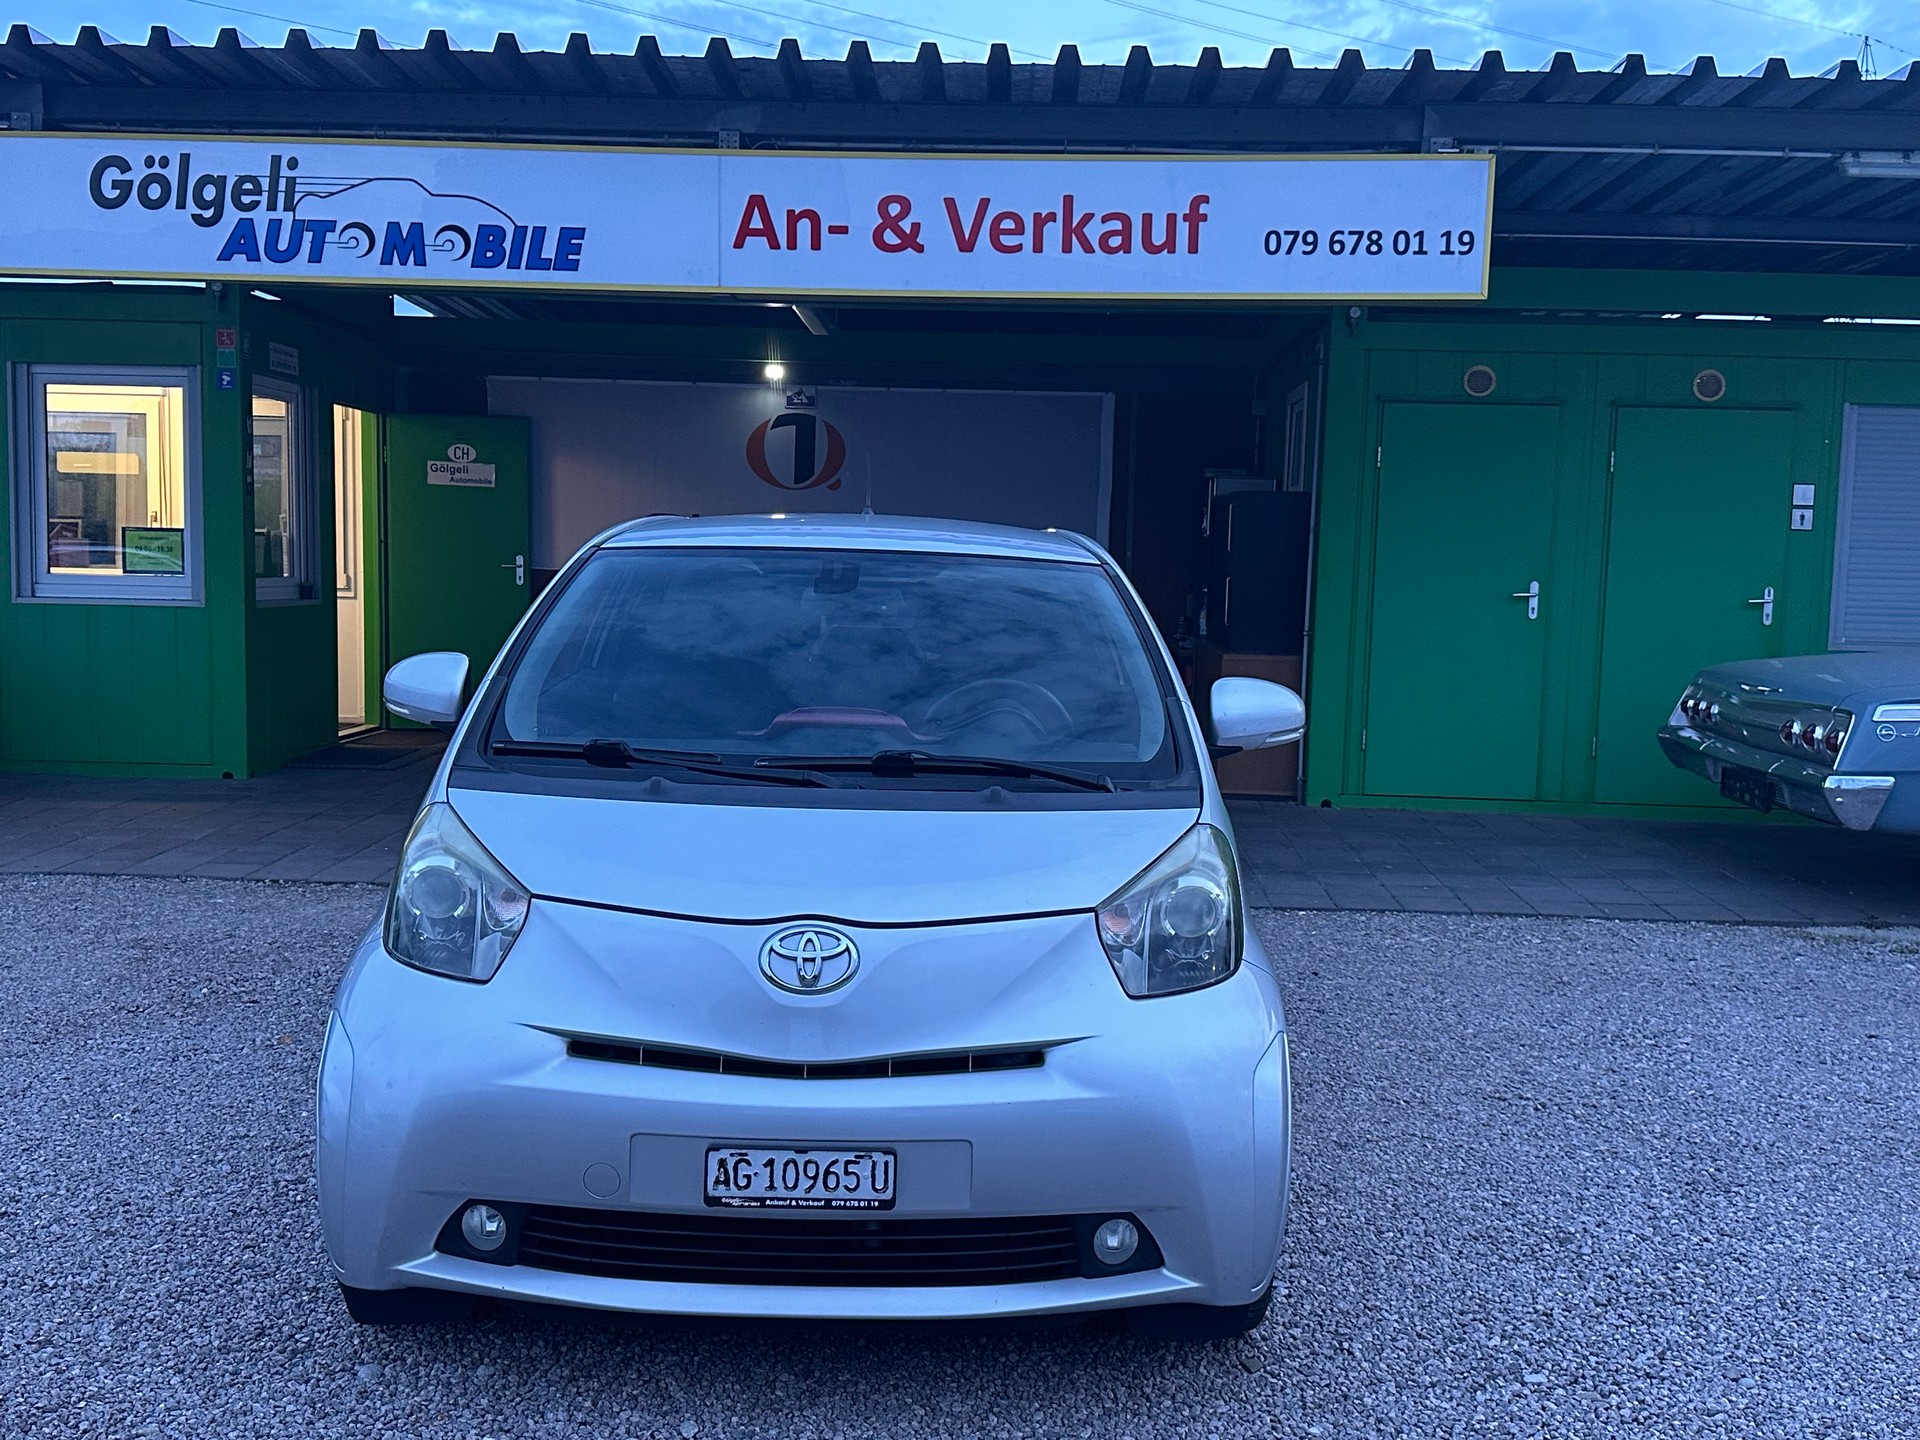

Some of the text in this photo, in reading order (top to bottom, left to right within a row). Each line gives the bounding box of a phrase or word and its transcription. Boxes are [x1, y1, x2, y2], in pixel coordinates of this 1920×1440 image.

[88, 154, 298, 227] Gölgeli
[733, 195, 1210, 256] An- & Verkauf
[216, 217, 586, 272] AUTOMOBILE
[1263, 230, 1475, 257] 079 678 01 19
[453, 446, 470, 460] CH
[430, 463, 469, 476] Gölgeli
[449, 476, 493, 485] Automobile
[765, 1199, 790, 1207] Ankauf
[798, 1200, 825, 1208] Verkauf
[831, 1200, 845, 1208] 079
